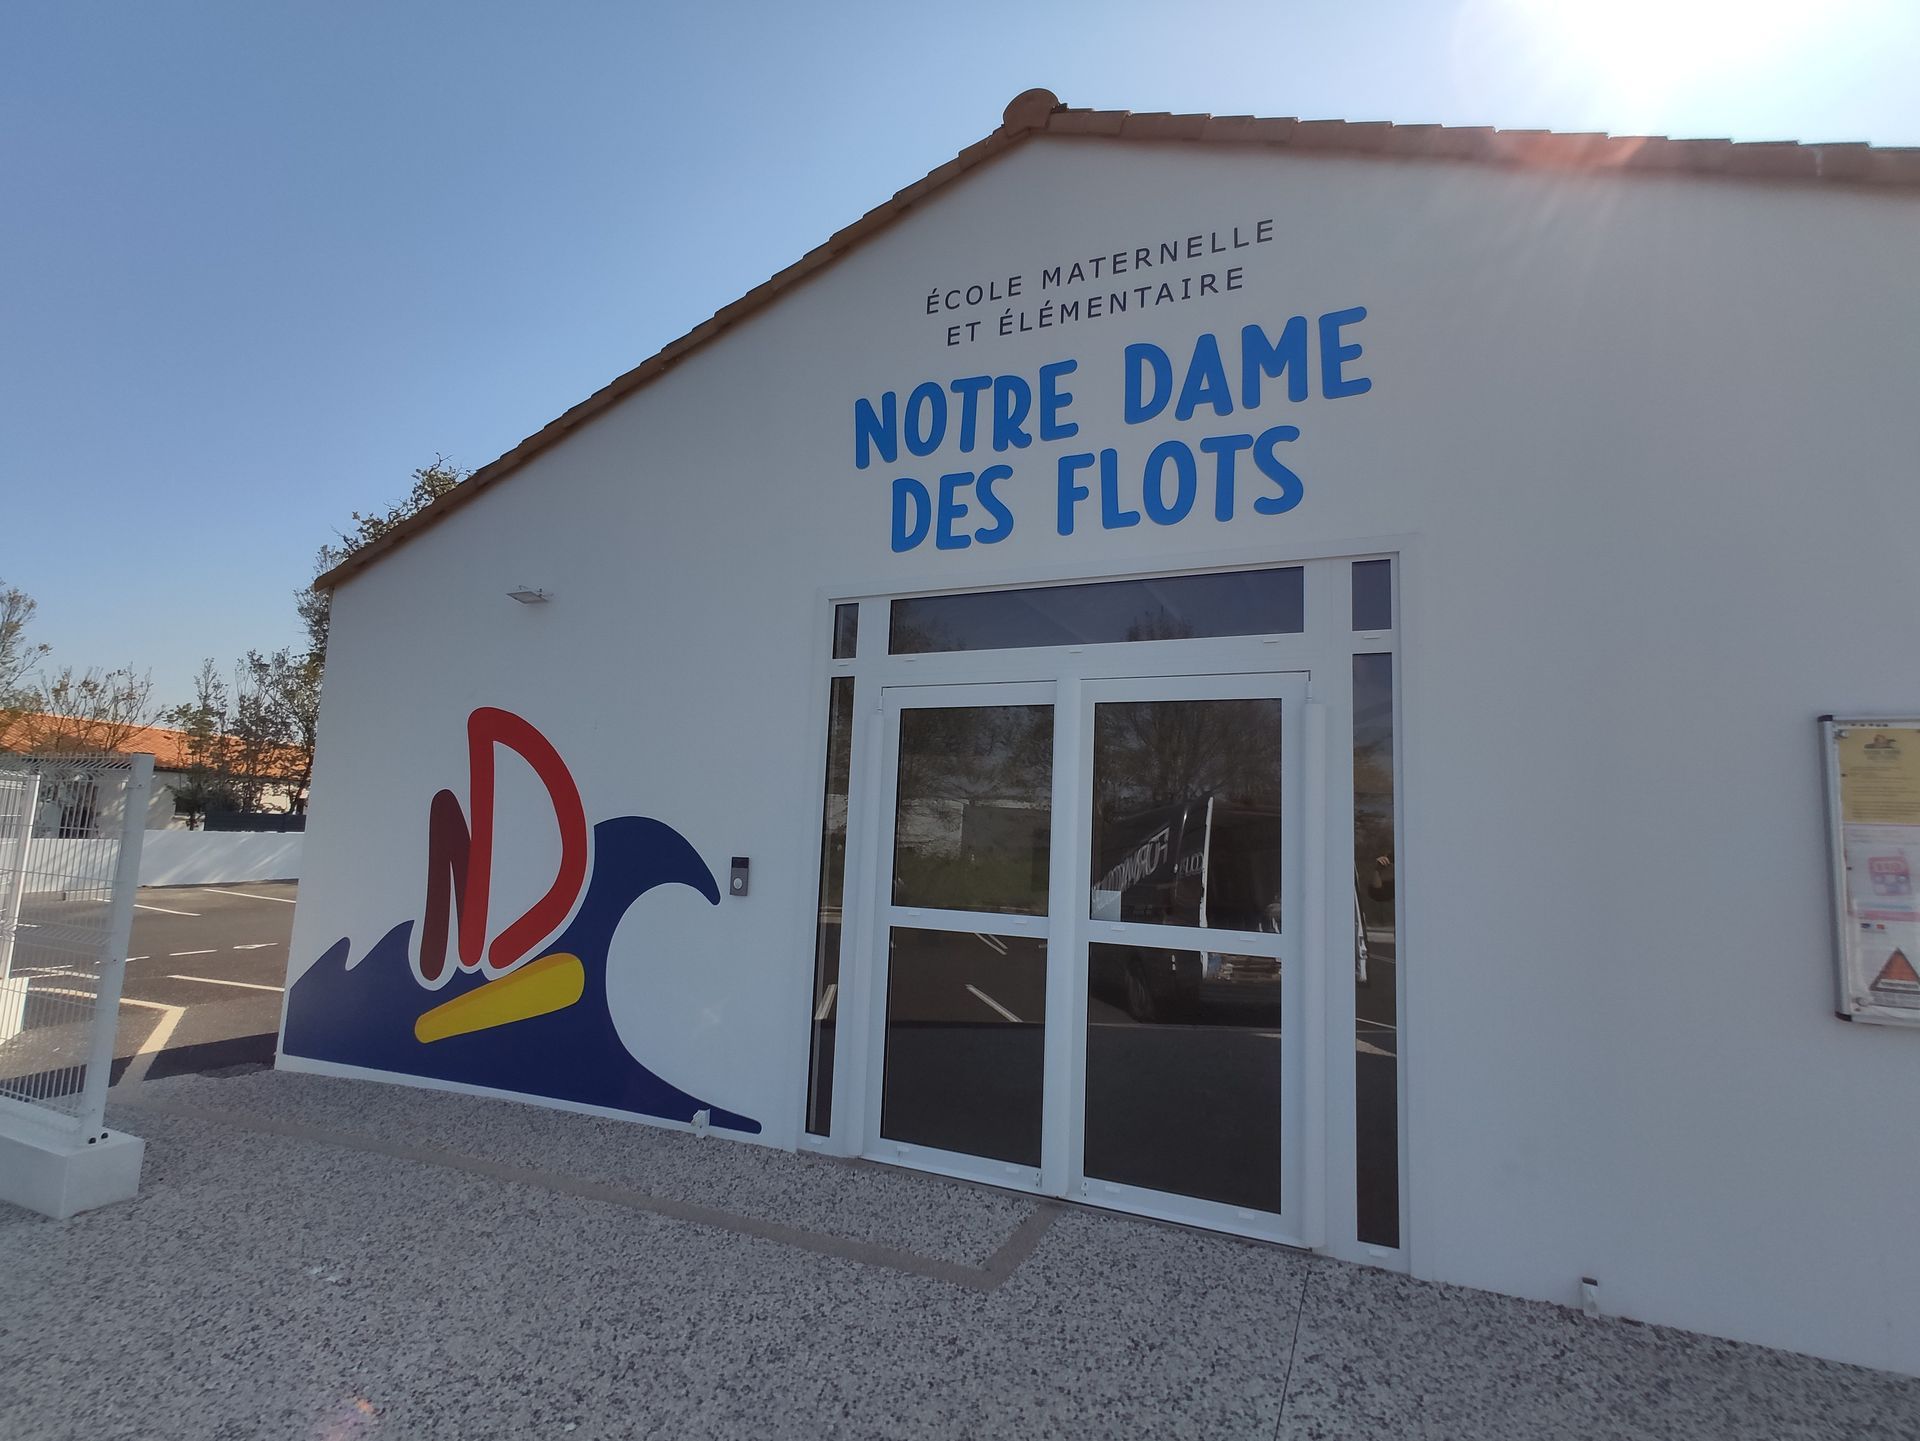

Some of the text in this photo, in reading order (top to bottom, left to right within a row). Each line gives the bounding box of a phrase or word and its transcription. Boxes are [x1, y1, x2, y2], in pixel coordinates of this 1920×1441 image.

[925, 219, 1274, 316] ÉCOLE MATERNELLE
[946, 266, 1244, 347] ET ÉLÉMENTAIRE
[854, 306, 1372, 470] NOTRE DAME
[891, 425, 1304, 553] DES FLOTS
